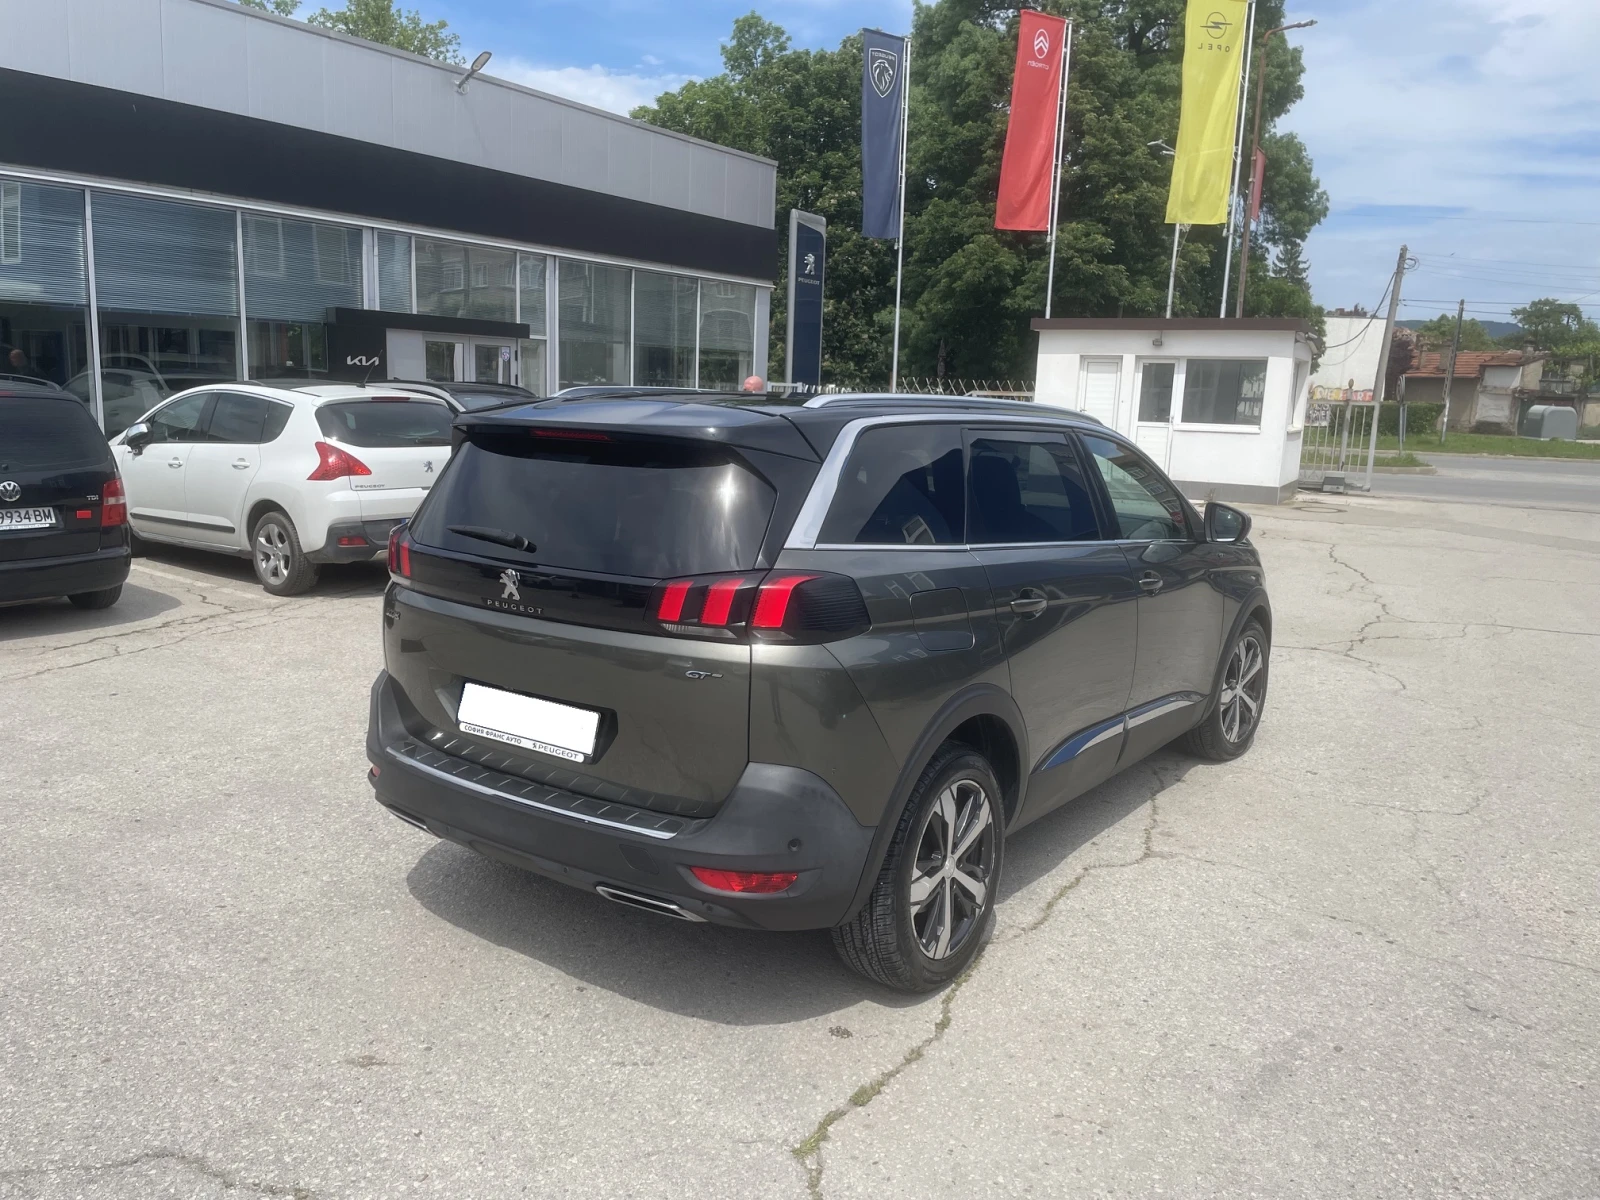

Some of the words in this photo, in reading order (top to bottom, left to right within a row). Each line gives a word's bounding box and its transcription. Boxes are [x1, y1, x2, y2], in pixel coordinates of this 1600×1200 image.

[797, 276, 820, 286] PEUGEOT
[346, 355, 379, 366] KIA
[487, 599, 543, 615] PEUGEOT
[685, 670, 711, 680] GT
[464, 724, 485, 735] СОФИЯ
[485, 730, 505, 741] ФРАНС
[505, 735, 522, 745] АУТО
[537, 744, 580, 760] PEUGEOT
